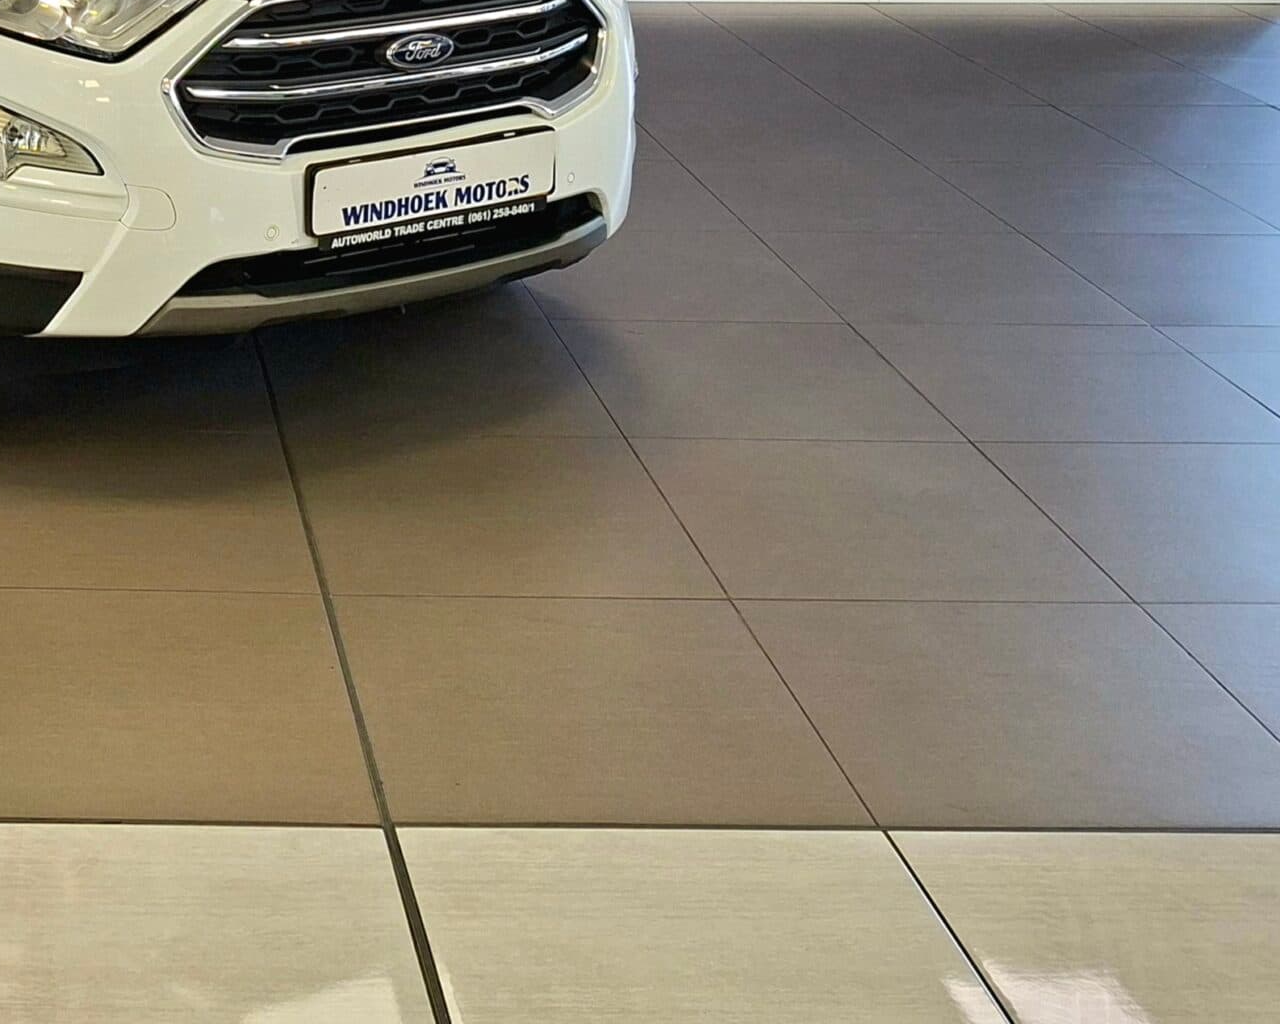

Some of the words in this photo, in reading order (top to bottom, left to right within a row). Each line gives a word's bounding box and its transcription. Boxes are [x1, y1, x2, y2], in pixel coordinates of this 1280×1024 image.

[403, 39, 442, 63] Ford
[341, 189, 449, 227] WINDHOEK
[330, 228, 392, 249] AUTOWORLD
[392, 222, 425, 237] TRADE
[426, 215, 465, 231] CENTRE
[467, 208, 492, 225] (061)
